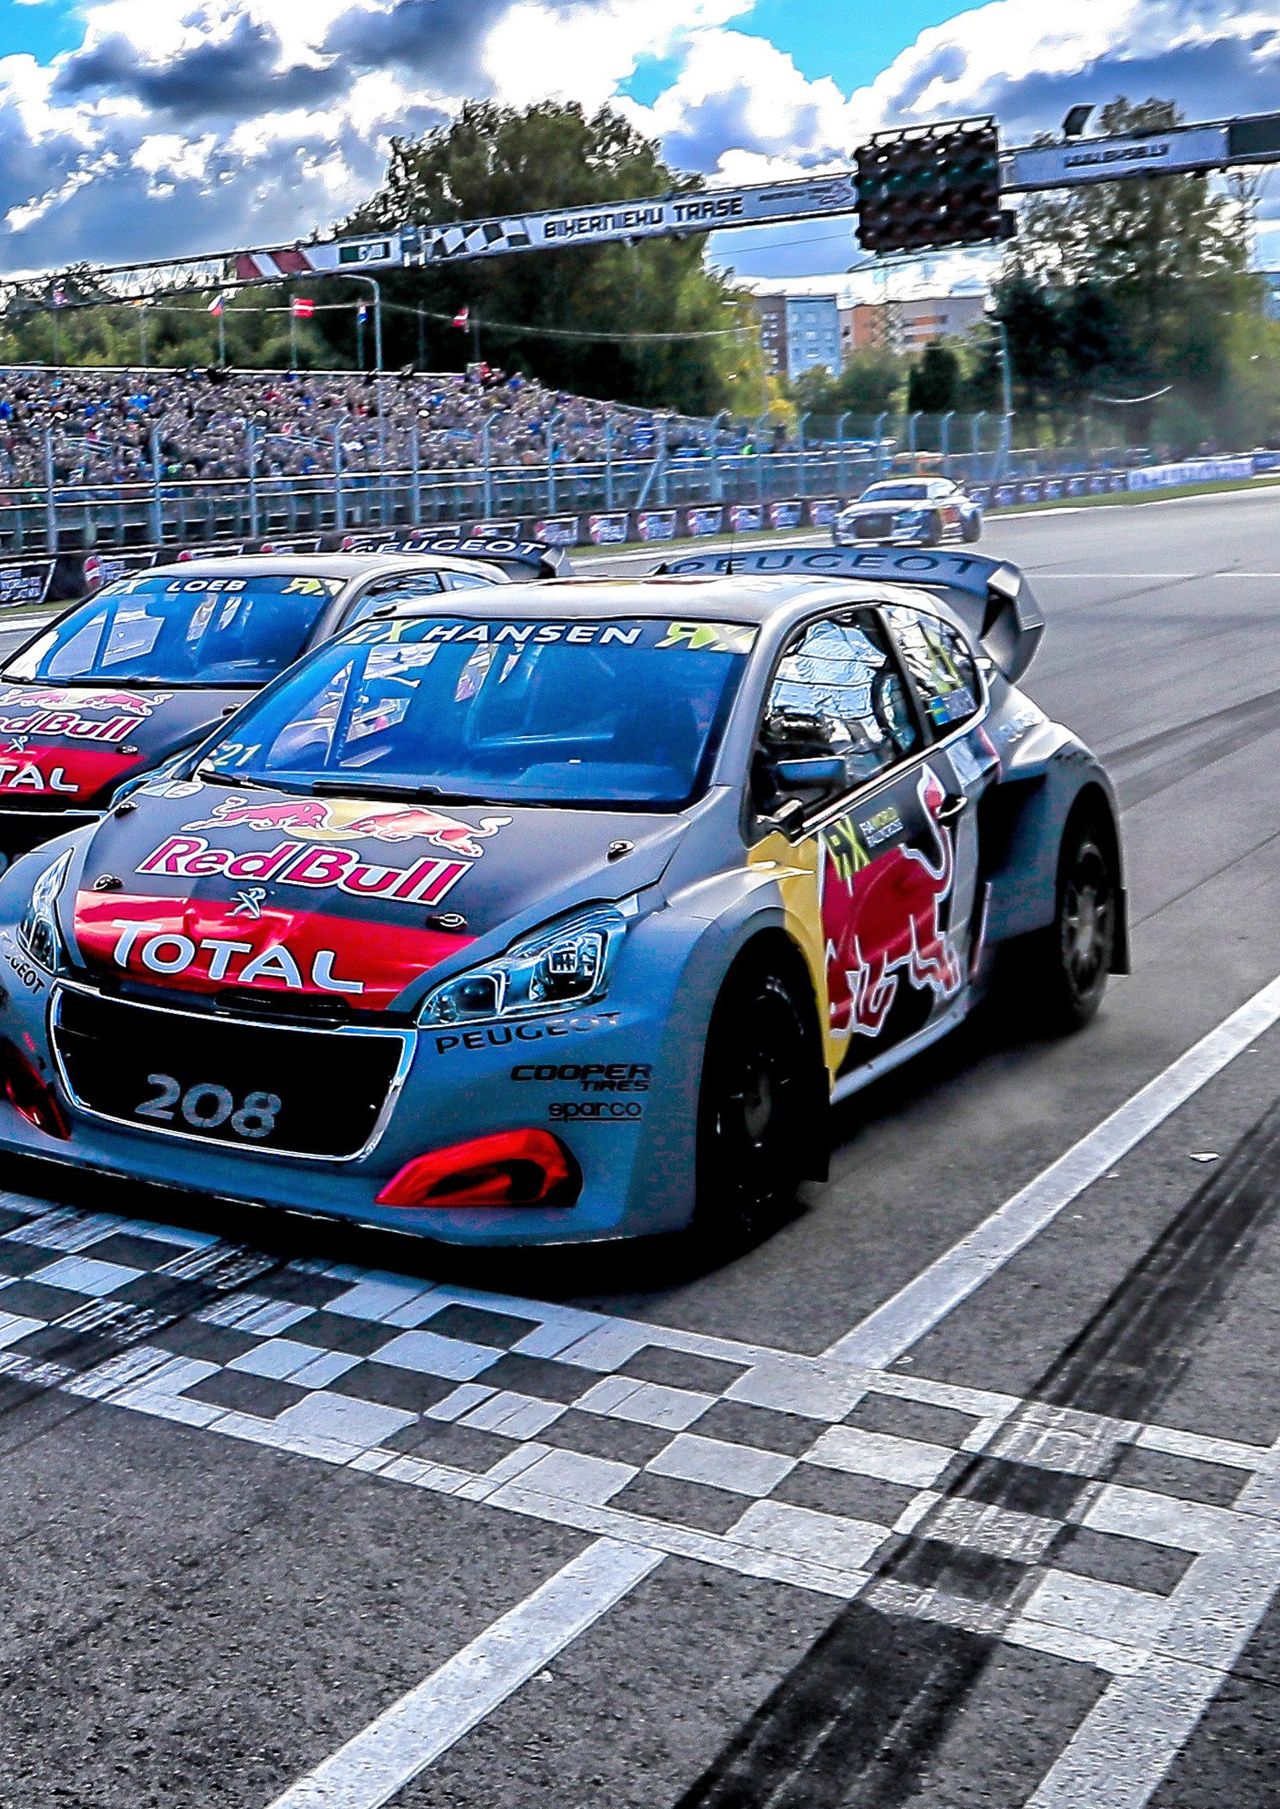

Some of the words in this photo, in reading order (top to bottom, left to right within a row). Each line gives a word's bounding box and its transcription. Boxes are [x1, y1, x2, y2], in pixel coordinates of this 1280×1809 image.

[673, 197, 744, 223] TRASE
[166, 579, 247, 593] LOEB
[424, 624, 642, 645] HANSEN
[214, 743, 261, 767] 21
[111, 920, 364, 994] TOTAL
[436, 1012, 620, 1055] PEUGEOT
[510, 1063, 653, 1081] COOPER
[581, 1080, 651, 1093] TIRES
[134, 1073, 283, 1138] 208
[548, 1101, 642, 1122] sparco
